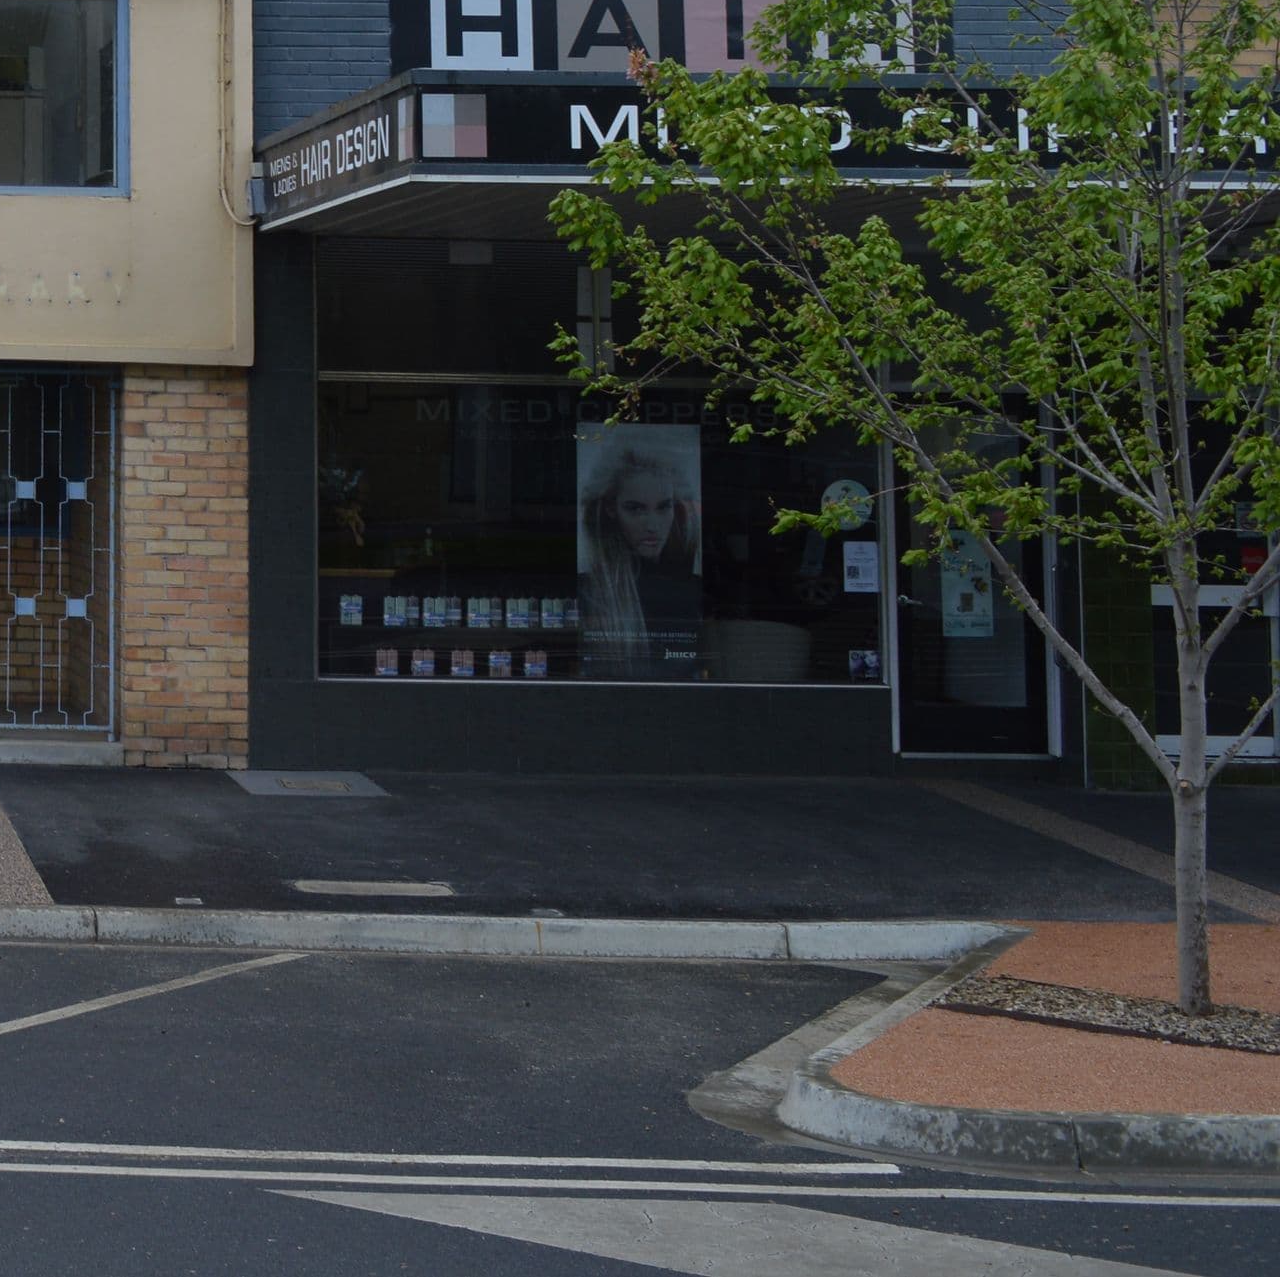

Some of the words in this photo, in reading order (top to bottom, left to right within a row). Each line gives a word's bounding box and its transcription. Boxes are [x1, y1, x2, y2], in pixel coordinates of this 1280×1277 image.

[569, 104, 852, 152] MID
[300, 139, 331, 187] HAIR
[336, 114, 389, 175] DESIGN
[270, 155, 291, 178] MENS
[273, 174, 297, 197] LADIES
[415, 400, 552, 424] MIXED
[575, 401, 778, 428] CPPERS
